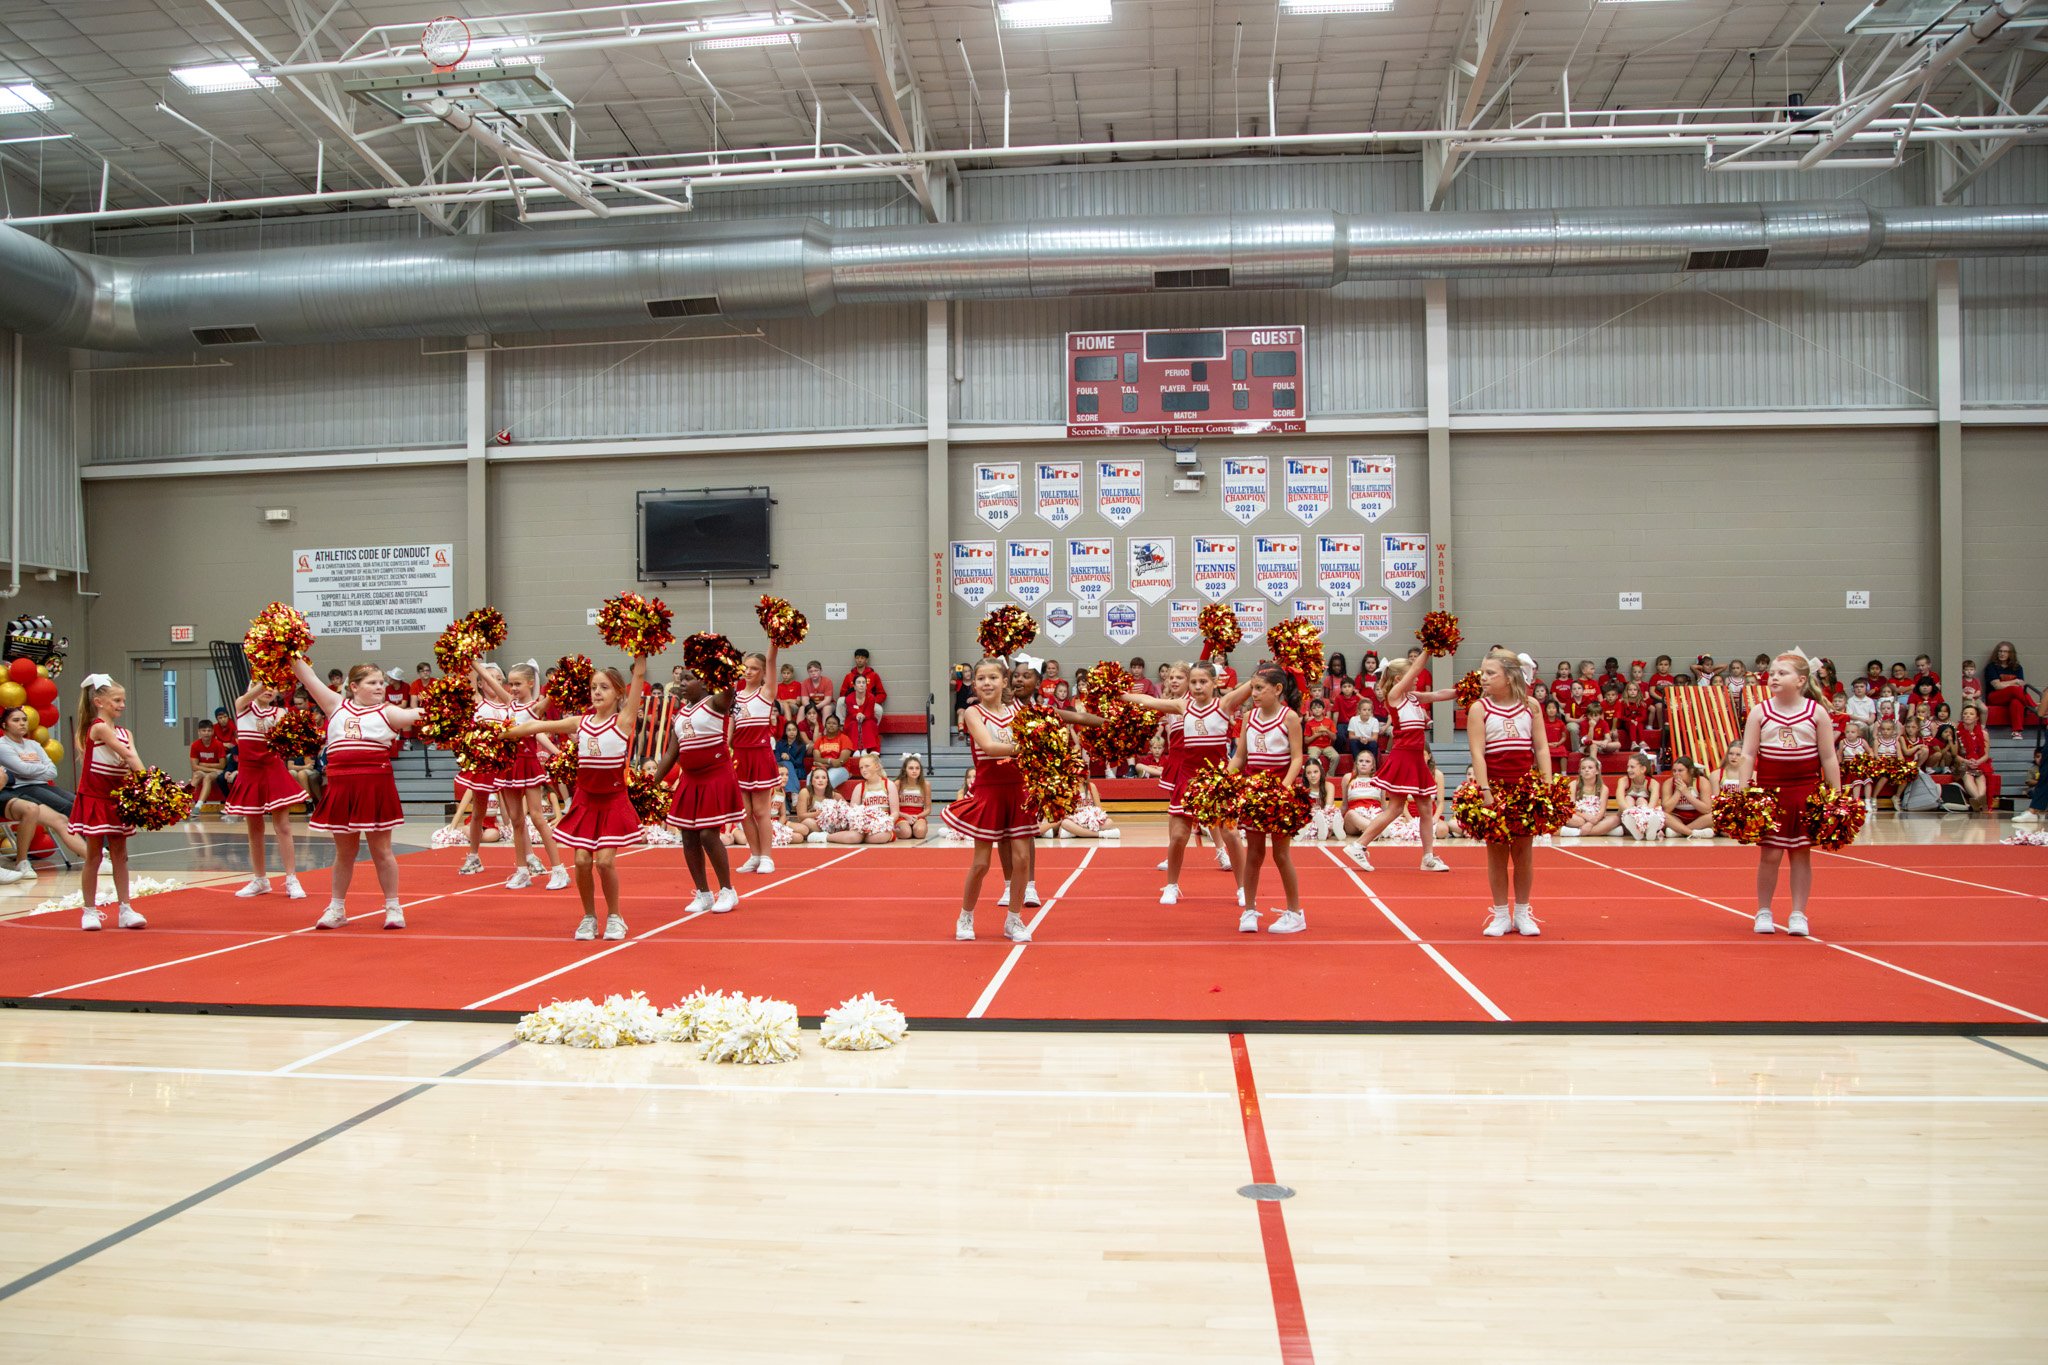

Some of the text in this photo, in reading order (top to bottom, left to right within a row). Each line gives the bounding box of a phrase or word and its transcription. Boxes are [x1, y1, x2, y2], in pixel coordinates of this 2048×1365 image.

[1252, 331, 1295, 345] GUEST
[1077, 336, 1115, 350] HOME
[1165, 369, 1189, 377] PERIOD
[1121, 386, 1138, 394] T.O.L.
[1232, 383, 1249, 391] T.O.L.
[1273, 382, 1295, 390] FOULS
[1072, 427, 1120, 437] Scoreboard
[1122, 426, 1159, 434] Donated
[1162, 425, 1173, 435] by
[1175, 425, 1204, 433] Electra
[1101, 489, 1140, 497] VOLLEYBALL
[1226, 486, 1265, 494] VOLLEYBALL
[1288, 485, 1328, 494] BASKETBALL
[1041, 490, 1079, 498] VOLLEYBALL
[1225, 494, 1265, 502] CHAMPION
[1288, 494, 1328, 502] RUNNERUP
[1352, 492, 1391, 500] CHAMPION
[979, 499, 1018, 508] CHAMPIONS
[1040, 497, 1079, 508] CHAMPION
[1101, 497, 1140, 505] CHAMPION
[989, 510, 1008, 519] 2018
[315, 547, 430, 561] ATHLETICS CODE OF CONDUCT
[1071, 566, 1110, 574] BASKETBALL
[1196, 564, 1235, 572] TENNIS
[1258, 564, 1297, 572] VOLLEYBALL
[1321, 563, 1360, 571] VOLLEYBALL
[955, 569, 993, 577] VOLLEYBALL
[1010, 568, 1049, 576] BASKETBALL
[1258, 572, 1298, 580] CHAMPION
[1321, 571, 1360, 580] CHAMPION
[1386, 571, 1425, 579] CHAMPION
[1436, 544, 1446, 608] WARRIORS
[955, 576, 993, 585] CHAMPION
[1010, 576, 1049, 585] CHAMPIONS
[1071, 574, 1110, 583] CHAMPIONS
[1196, 572, 1235, 581] CHAMPION
[934, 553, 943, 616] WARRIORS
[1131, 579, 1171, 588] CHAMPION
[176, 628, 189, 639] EXIT
